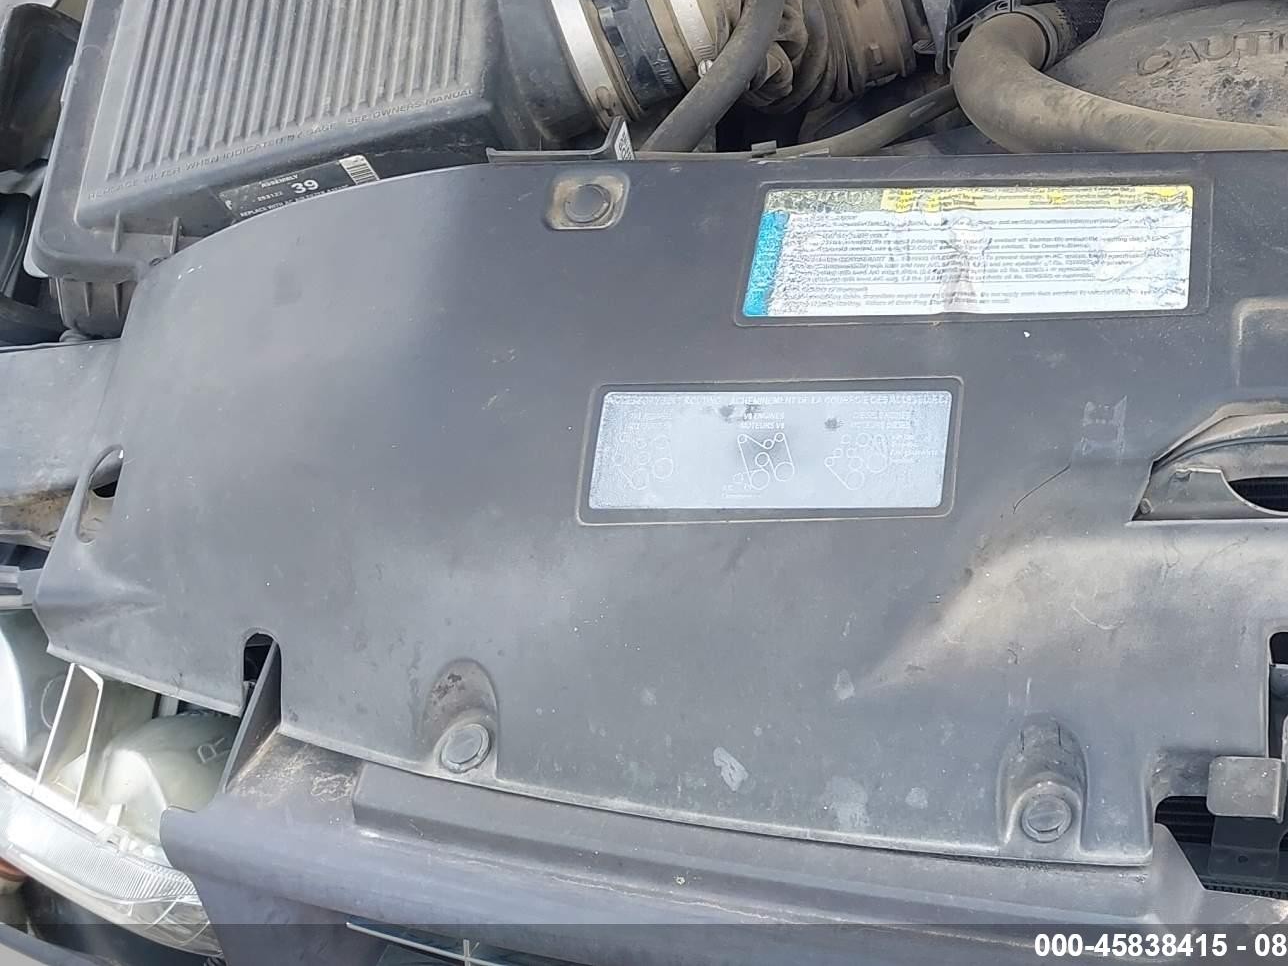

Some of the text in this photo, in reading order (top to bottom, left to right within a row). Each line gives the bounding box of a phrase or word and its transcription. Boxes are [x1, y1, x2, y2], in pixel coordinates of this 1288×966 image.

[185, 153, 220, 171] WHEN
[345, 112, 370, 126] SEE
[425, 87, 474, 107] MANUAL
[261, 173, 299, 188] ASSEMBLY
[290, 179, 319, 194] 39
[240, 205, 268, 218] REPLACE
[268, 201, 284, 211] WITH
